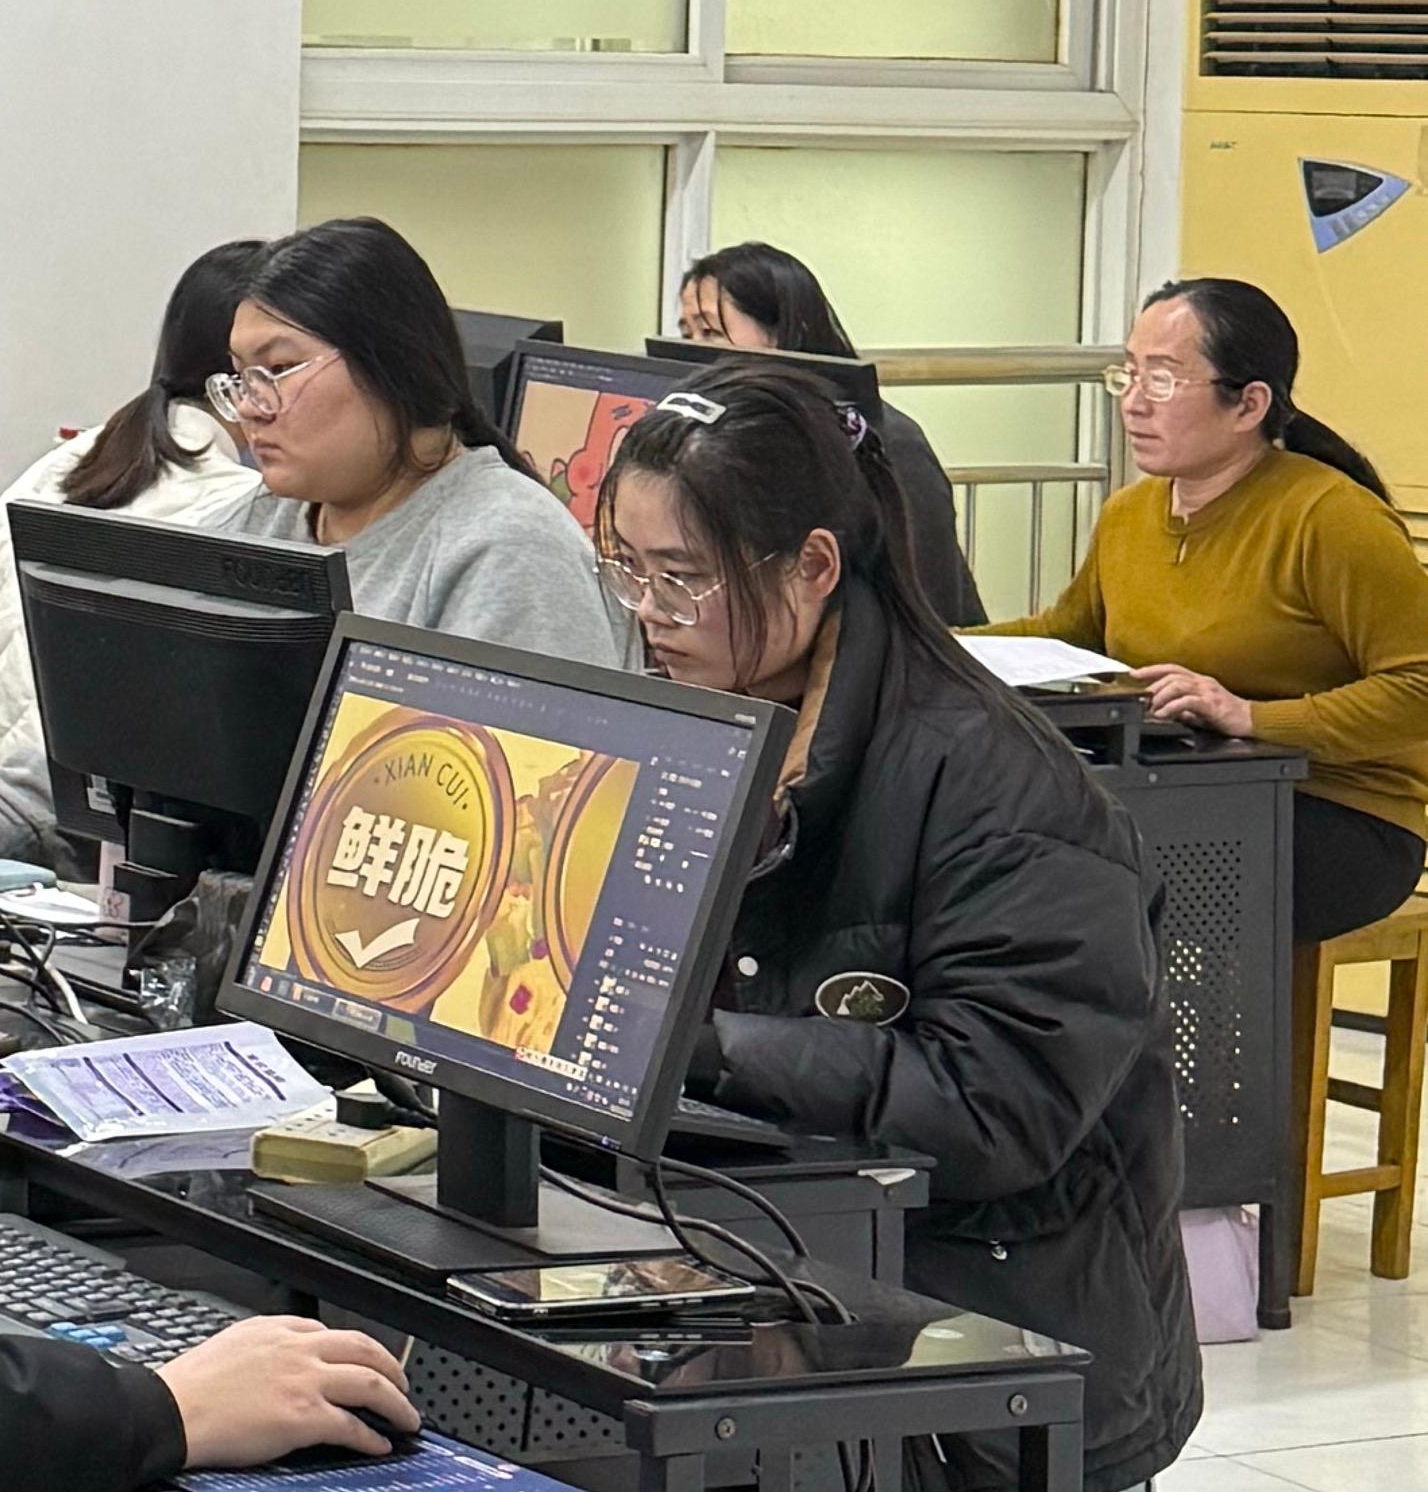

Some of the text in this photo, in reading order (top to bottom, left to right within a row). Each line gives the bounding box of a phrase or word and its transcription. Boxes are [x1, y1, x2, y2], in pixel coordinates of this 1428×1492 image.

[385, 753, 469, 805] XIAN CUI
[326, 805, 470, 919] 鲜脆
